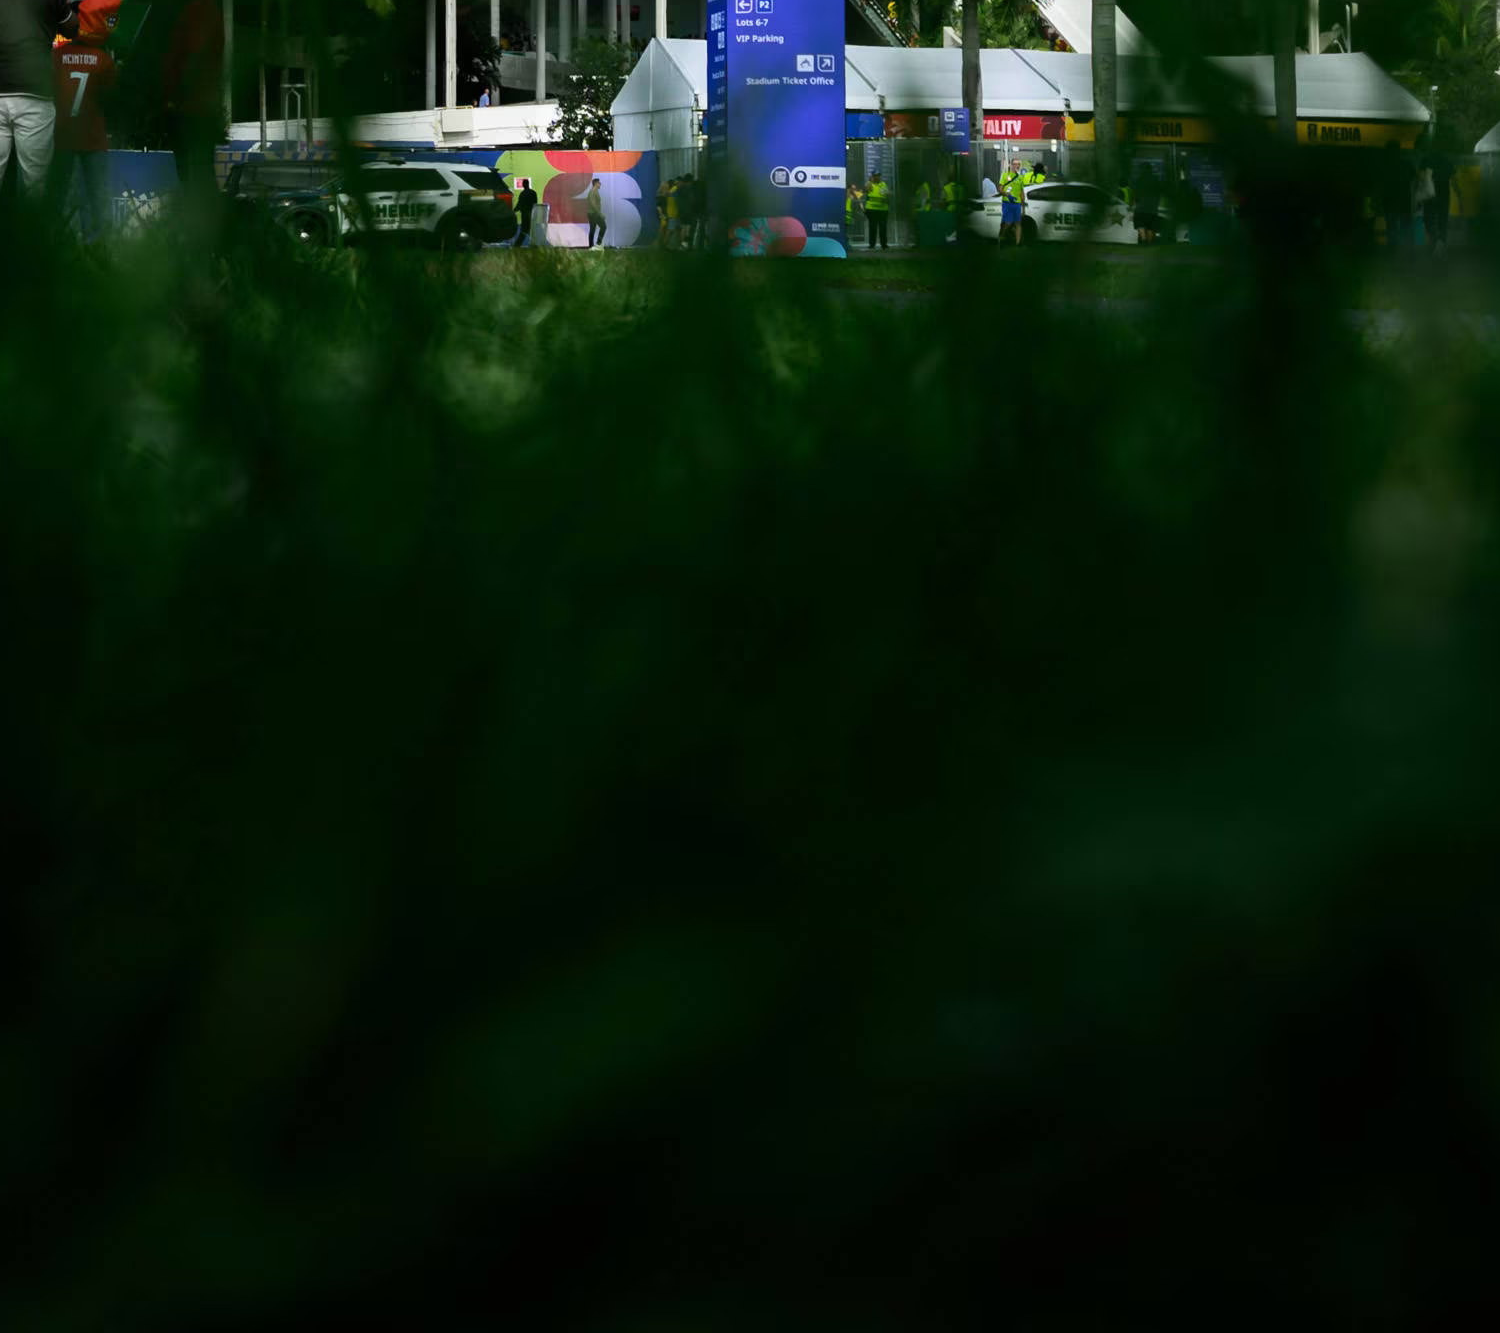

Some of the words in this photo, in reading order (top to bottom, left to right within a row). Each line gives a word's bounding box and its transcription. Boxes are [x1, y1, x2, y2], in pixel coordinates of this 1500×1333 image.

[759, 1, 770, 9] P2
[736, 18, 754, 27] Lots
[755, 18, 769, 27] 6-7
[736, 35, 750, 43] VIP
[752, 34, 785, 45] Parking
[746, 77, 780, 86] Stadium
[782, 77, 808, 86] Ticket
[809, 77, 835, 86] Office
[70, 71, 89, 117] 7
[983, 119, 1022, 136] TALITY
[1320, 126, 1361, 142] MEDIA
